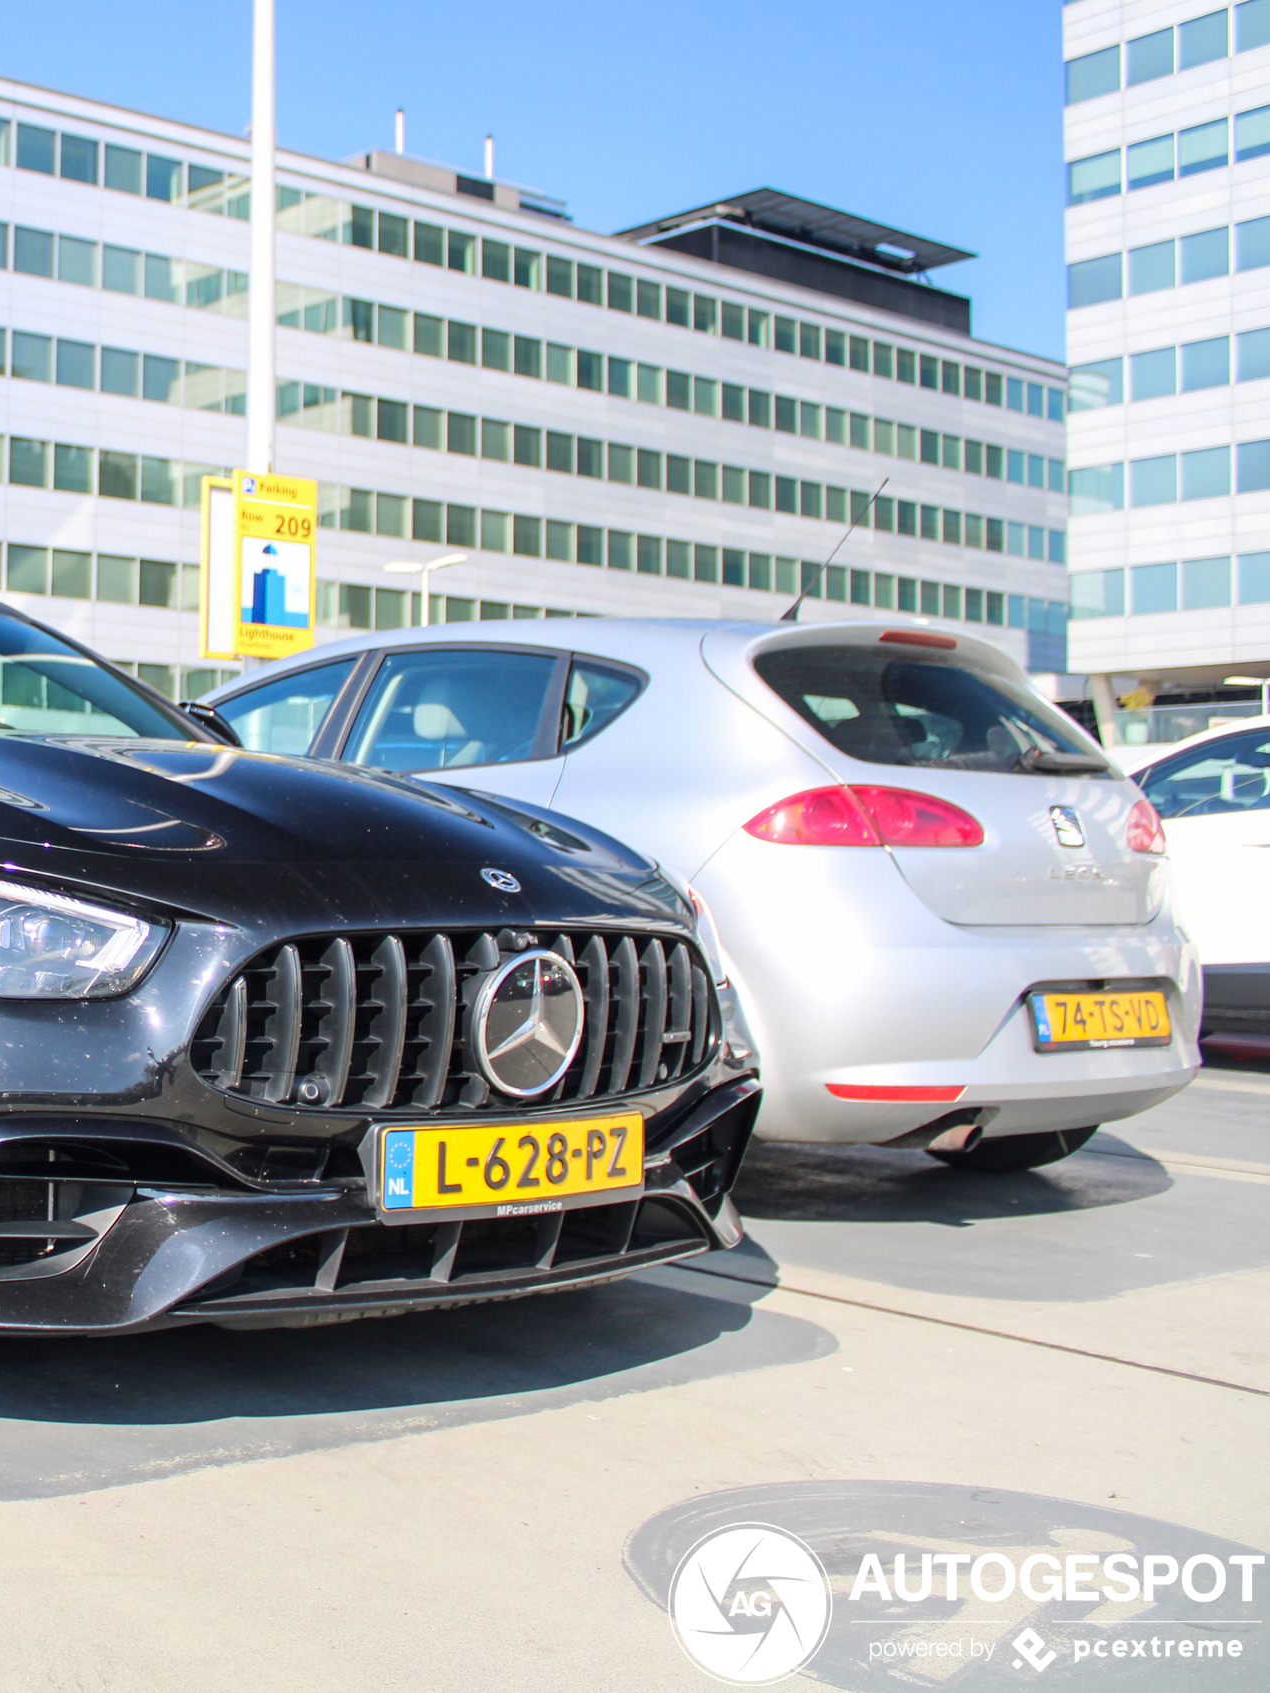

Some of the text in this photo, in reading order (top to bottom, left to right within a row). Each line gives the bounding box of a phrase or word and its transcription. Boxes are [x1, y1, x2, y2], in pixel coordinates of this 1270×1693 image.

[260, 481, 297, 499] Parking
[242, 510, 311, 538] Row 209
[239, 627, 295, 641] Lighthouse
[437, 1127, 628, 1194] L-628-PZ
[388, 1178, 410, 1195] NL
[497, 1201, 563, 1216] MPcarservice
